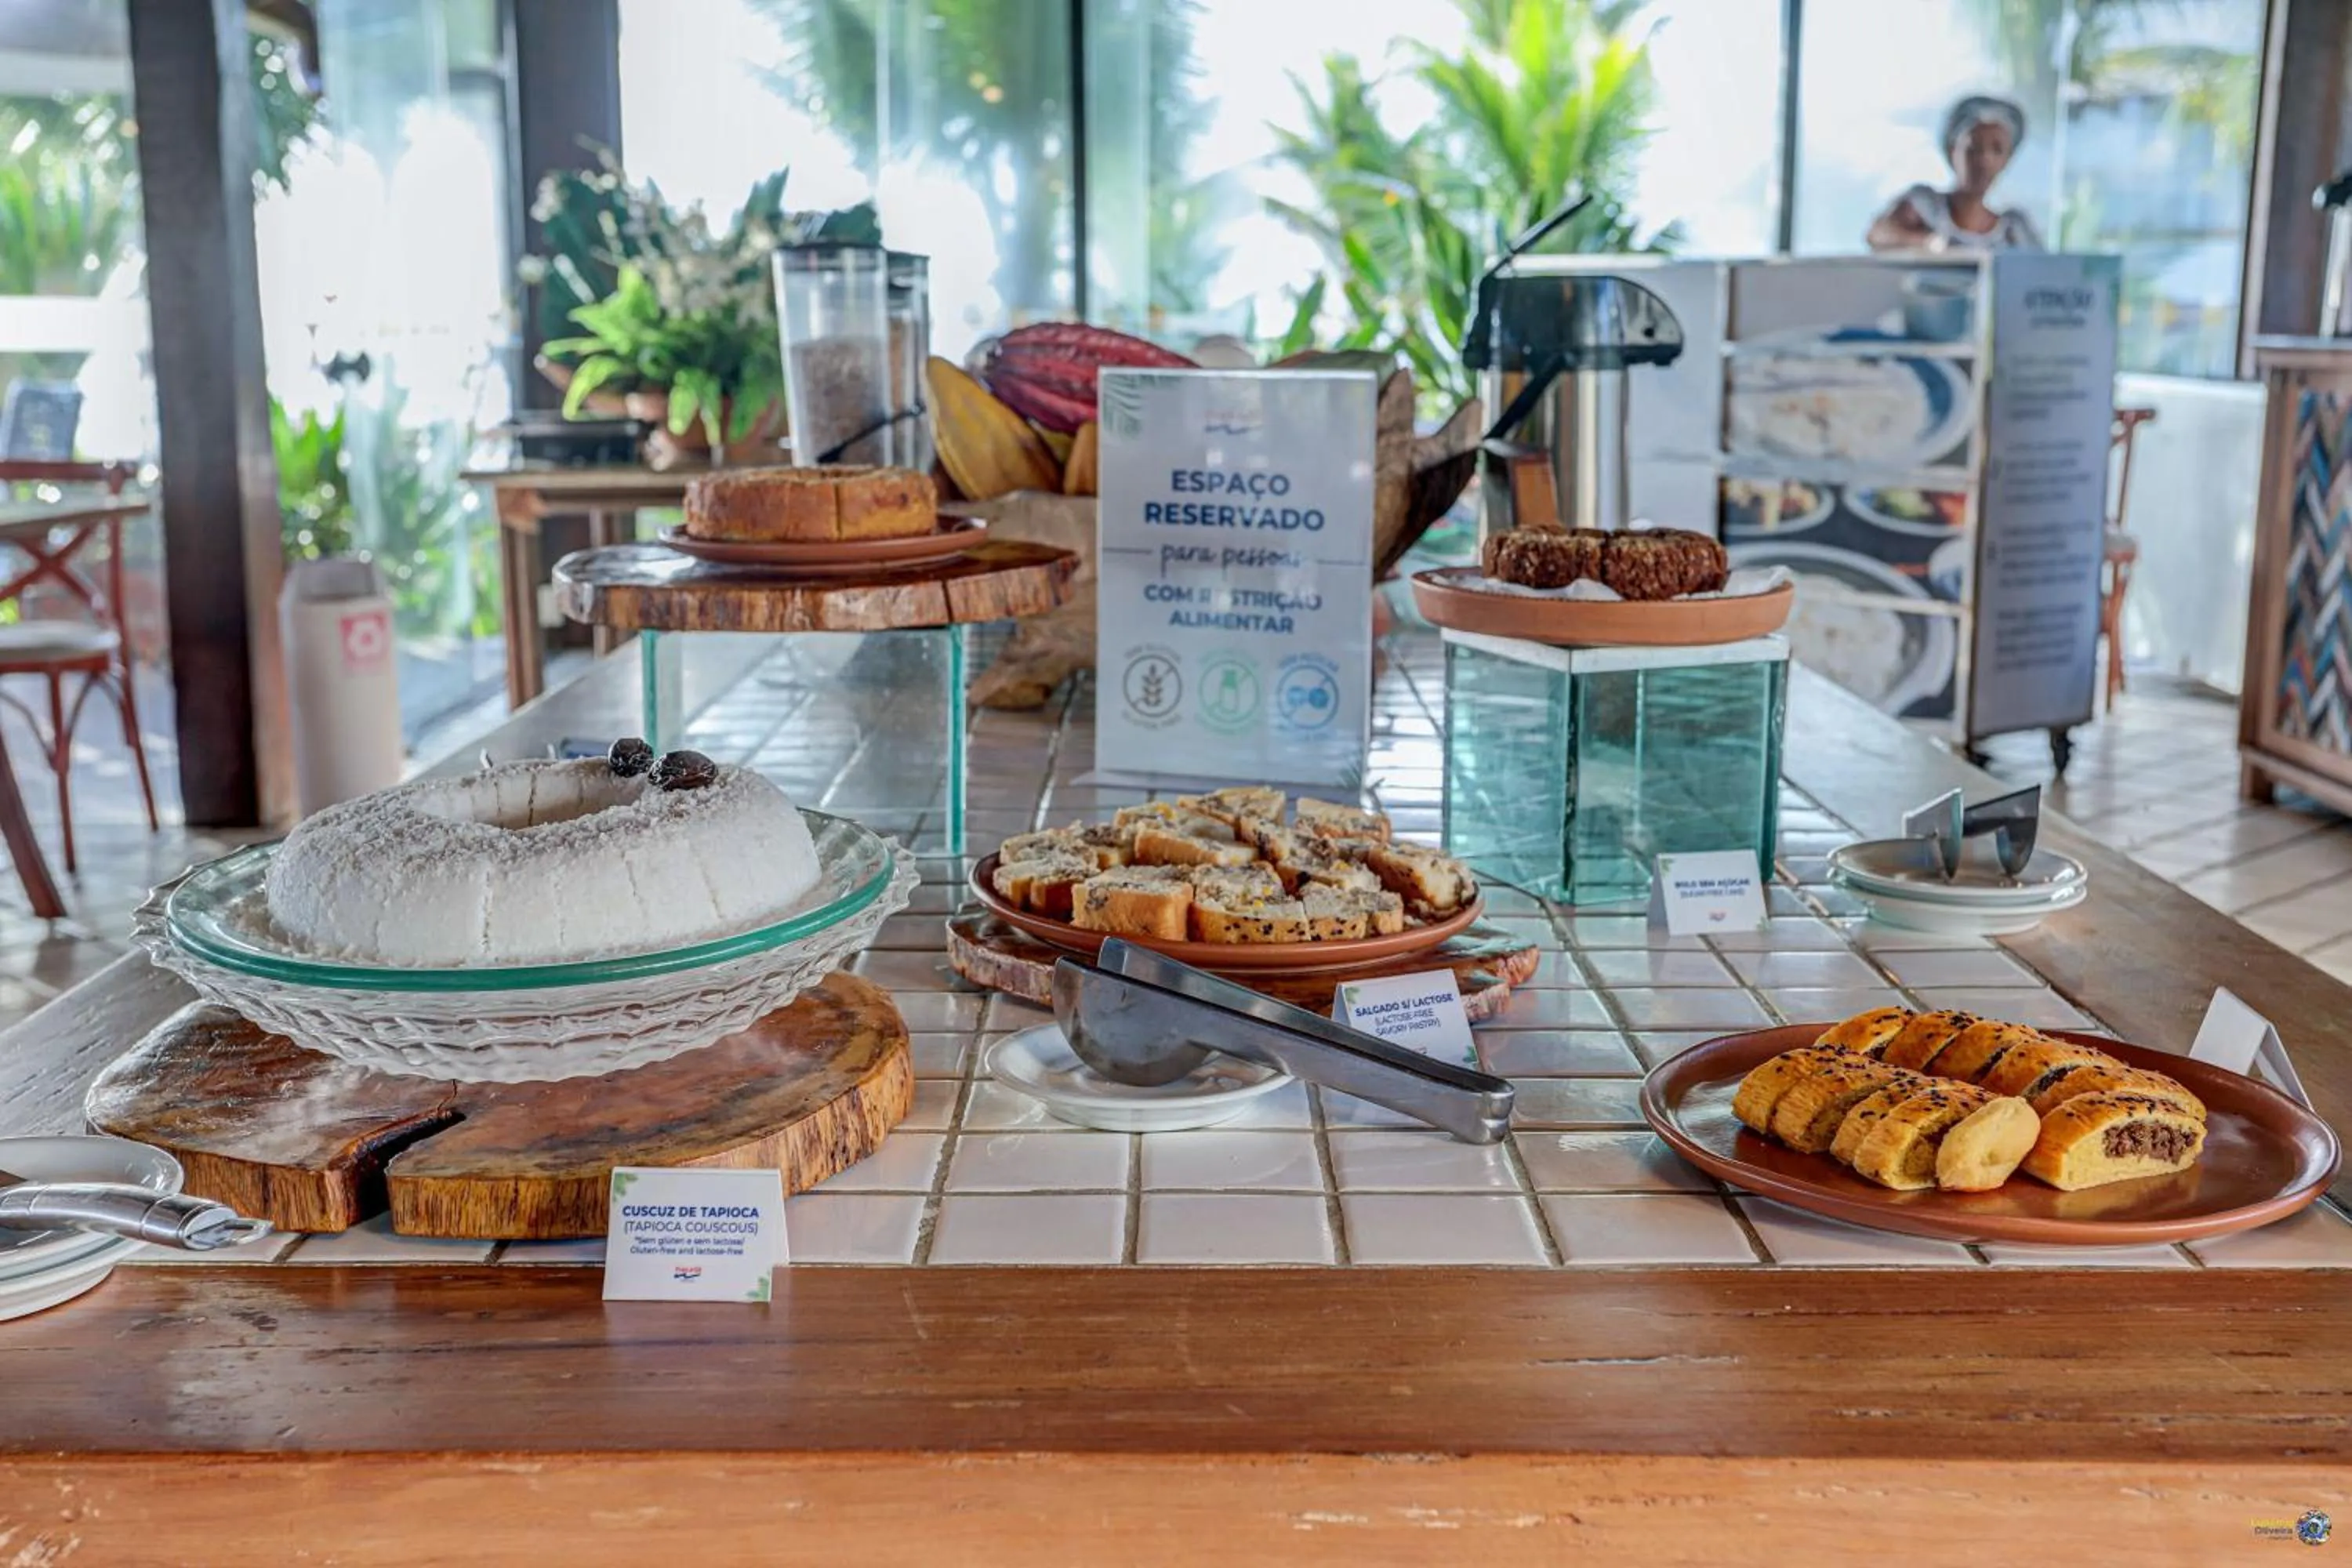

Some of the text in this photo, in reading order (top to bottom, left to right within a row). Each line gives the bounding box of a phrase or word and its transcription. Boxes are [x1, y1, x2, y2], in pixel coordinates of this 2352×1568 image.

[1171, 469, 1290, 500] ESPAÇO
[1144, 503, 1325, 532] RESERVADO
[1161, 543, 1215, 579] para
[1143, 584, 1193, 602] COM
[1168, 609, 1294, 633] ALIMENTAR
[1355, 1003, 1399, 1017] SALGADO
[1413, 993, 1454, 1007] LACTOSE
[622, 1206, 759, 1218] CUSCUZ DE TAPIOCA
[624, 1221, 758, 1235] (TAPIOCA COUSCOUS)
